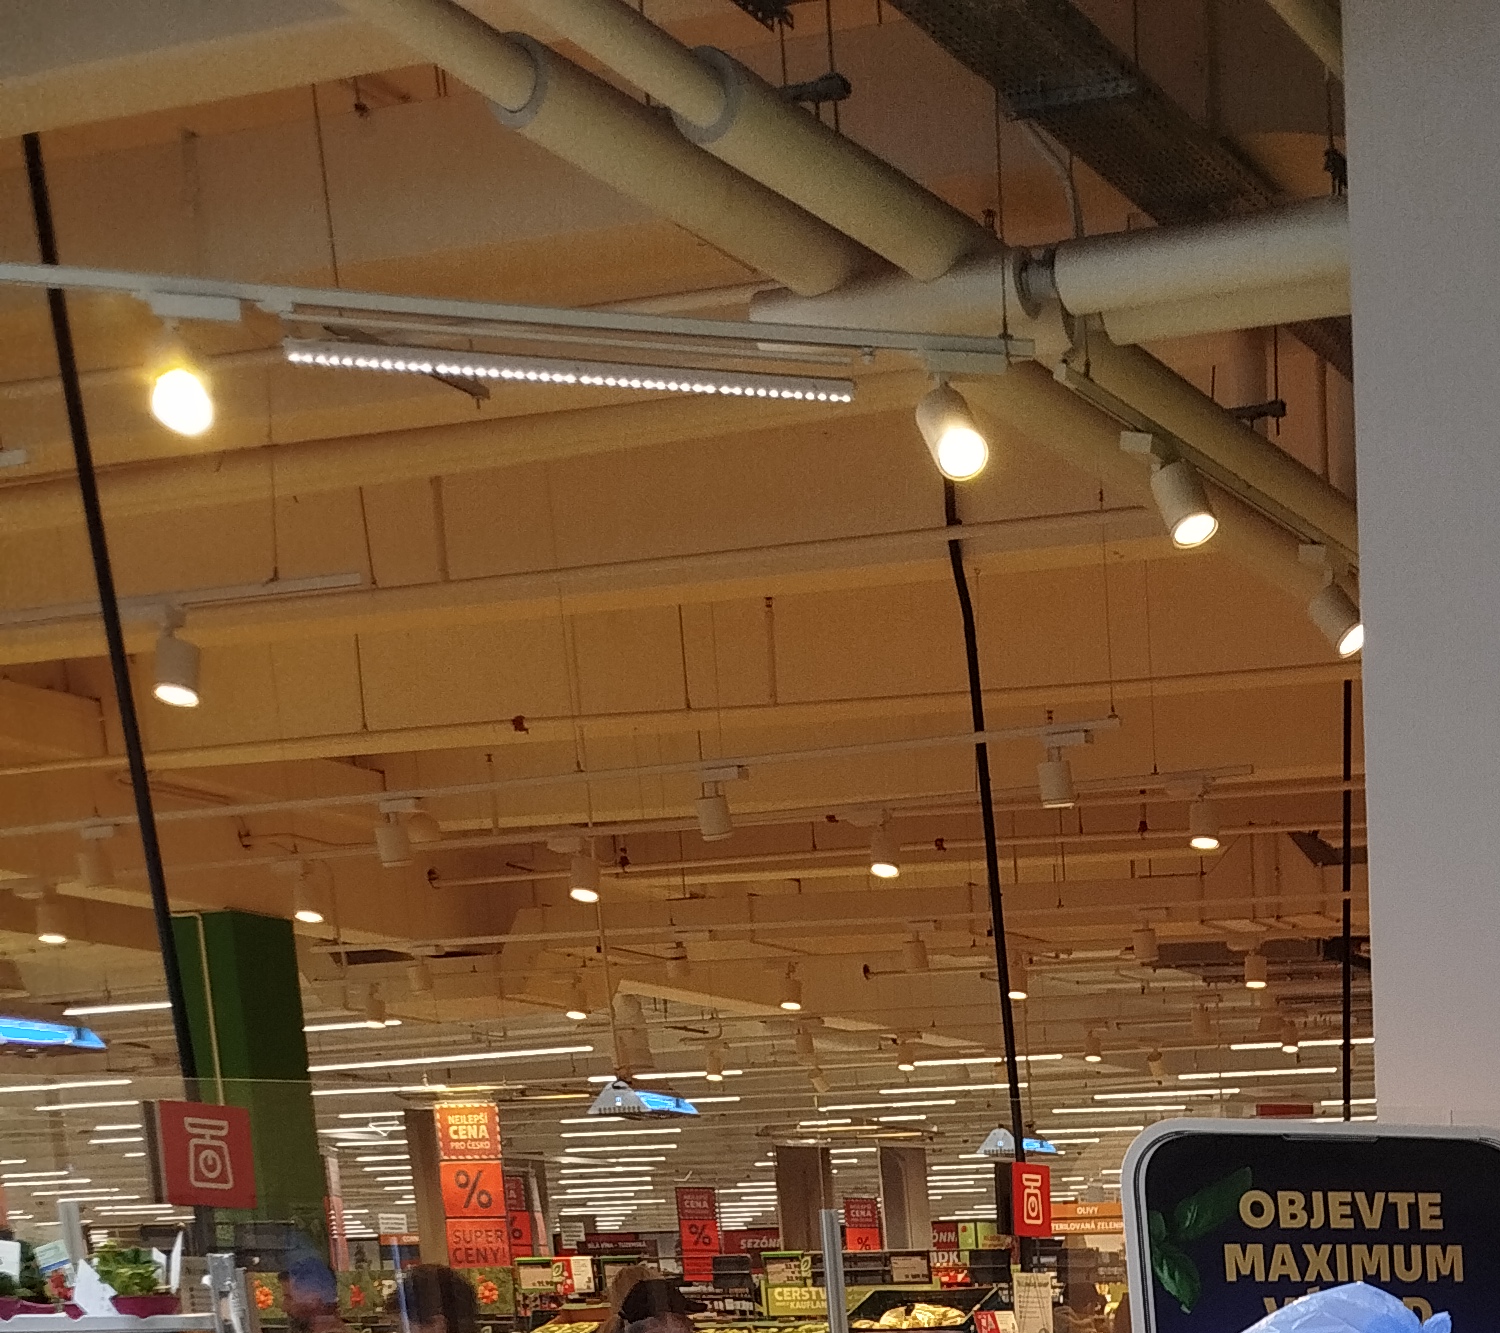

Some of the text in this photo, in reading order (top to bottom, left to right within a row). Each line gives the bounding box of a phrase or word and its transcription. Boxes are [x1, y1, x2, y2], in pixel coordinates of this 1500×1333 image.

[447, 1112, 488, 1125] NEJLEPŠÍ
[449, 1126, 490, 1140] CENA
[450, 1141, 466, 1149] PRO
[684, 1200, 709, 1209] CENA
[1076, 1206, 1099, 1214] OLIVY
[1238, 1189, 1444, 1230] OBJEVTE
[452, 1229, 504, 1245] SUPER
[452, 1246, 507, 1264] CENY!
[1223, 1243, 1464, 1282] MAXIMUM
